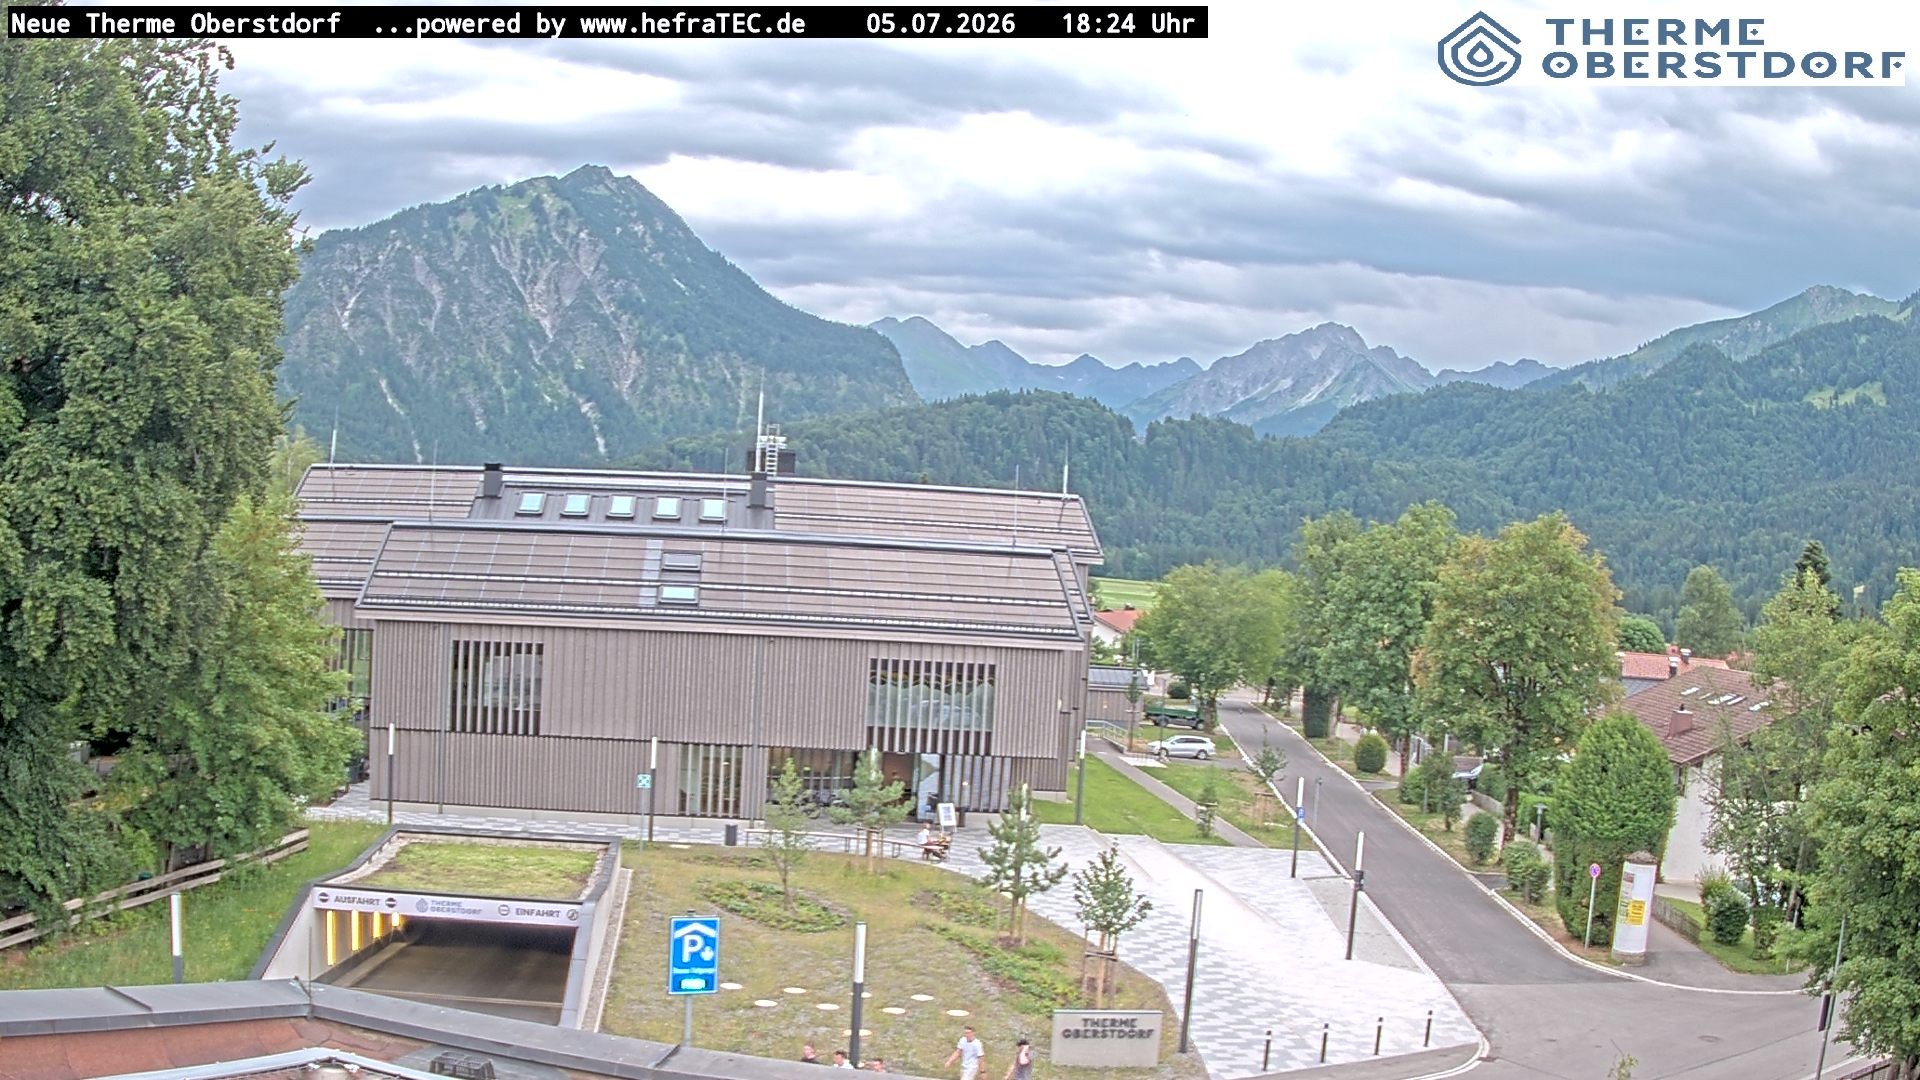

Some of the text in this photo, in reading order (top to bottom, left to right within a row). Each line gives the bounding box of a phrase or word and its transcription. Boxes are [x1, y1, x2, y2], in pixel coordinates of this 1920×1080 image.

[334, 895, 381, 906] AUSFAHRT
[515, 907, 561, 918] EINFAHRT
[682, 935, 704, 963] P
[1082, 1018, 1138, 1028] THERME
[1062, 1029, 1154, 1039] OBERSTDORF
